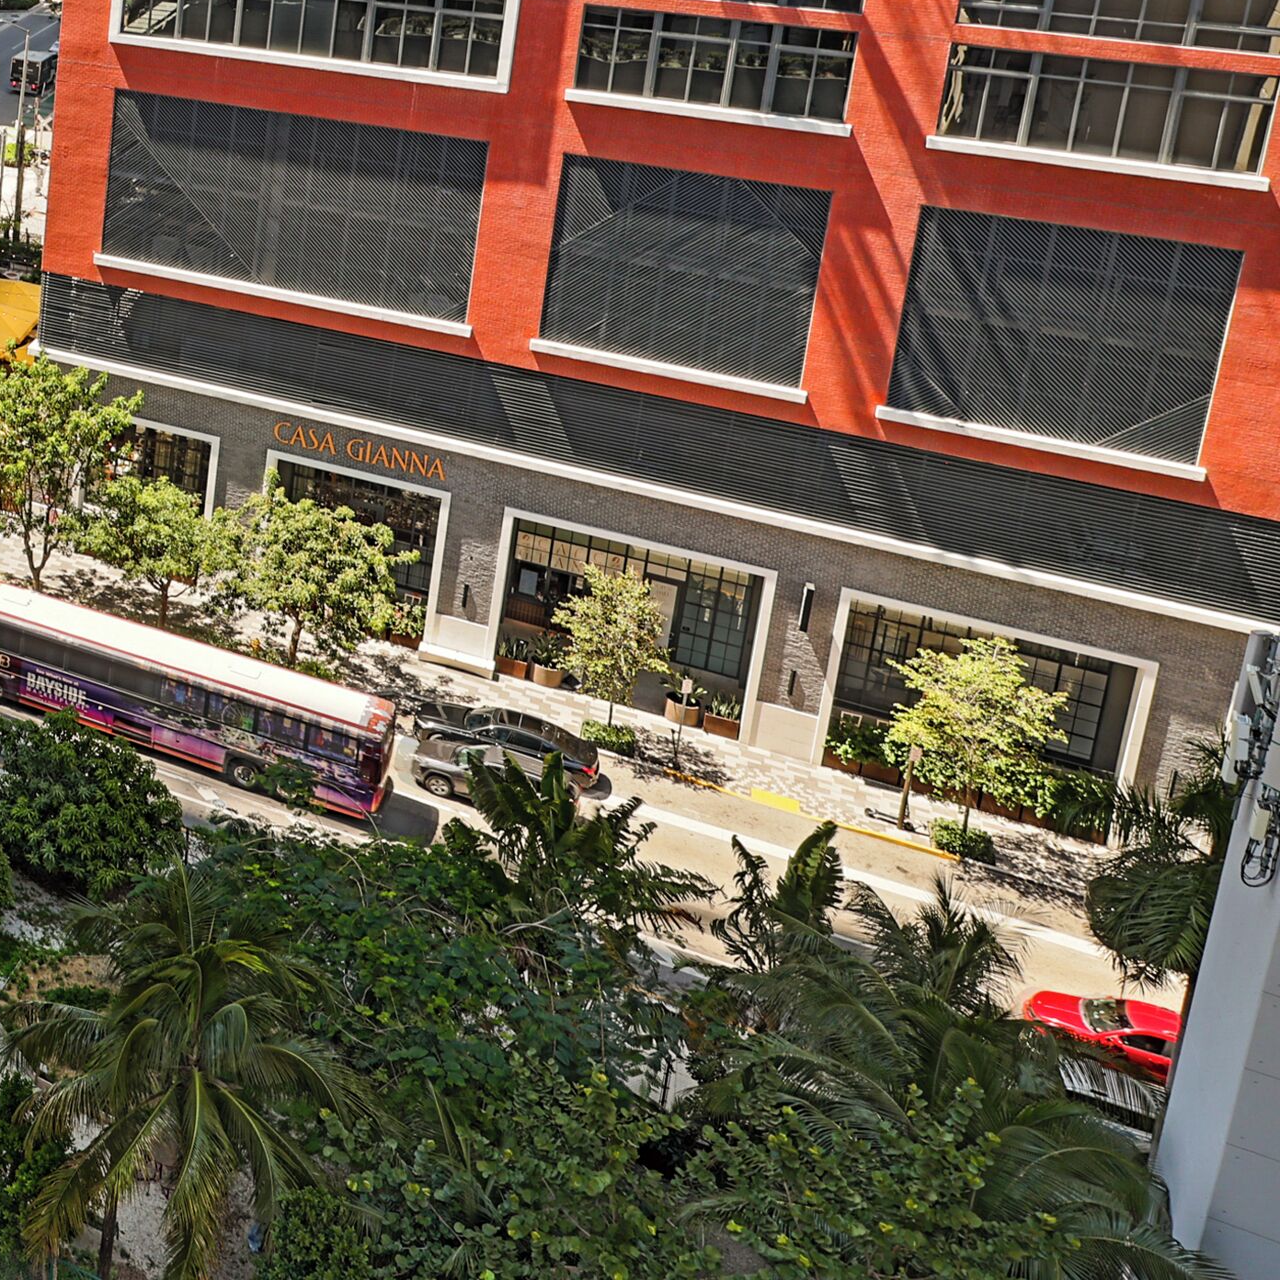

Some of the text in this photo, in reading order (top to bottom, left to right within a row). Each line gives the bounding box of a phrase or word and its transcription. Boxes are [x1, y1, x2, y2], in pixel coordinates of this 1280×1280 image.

[273, 421, 447, 482] CASA GIANNA
[26, 672, 87, 705] BAYSIDE
